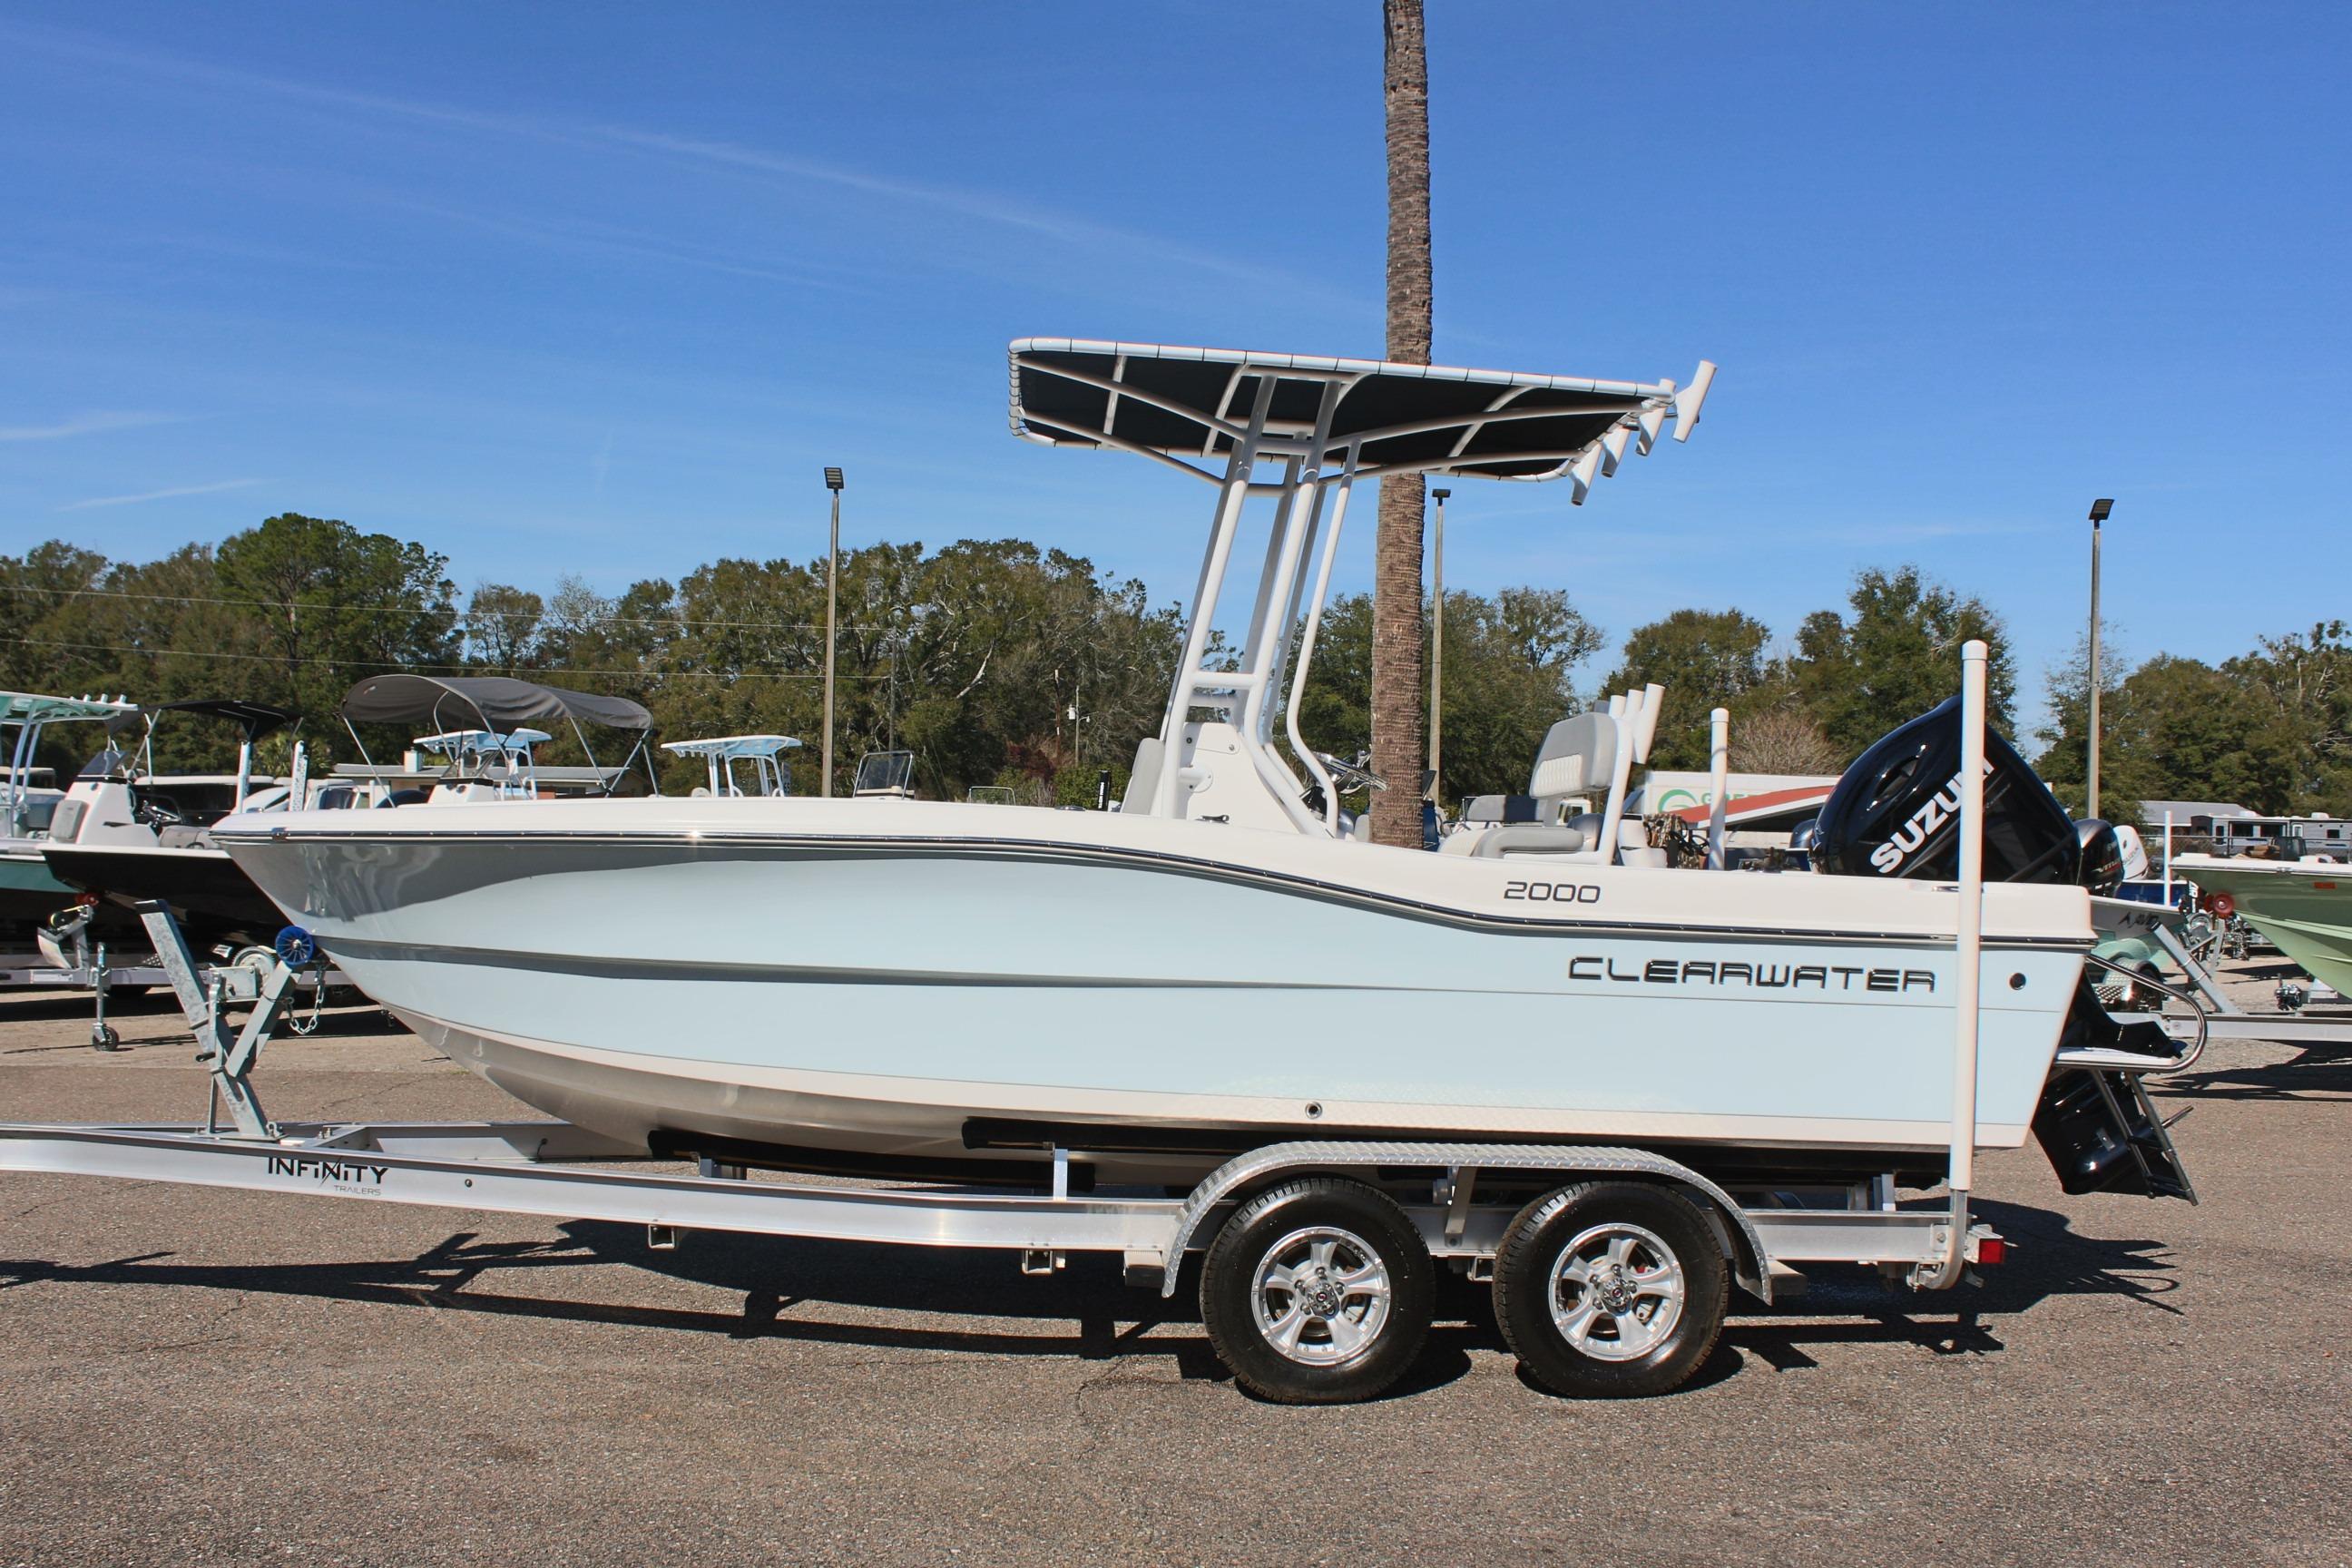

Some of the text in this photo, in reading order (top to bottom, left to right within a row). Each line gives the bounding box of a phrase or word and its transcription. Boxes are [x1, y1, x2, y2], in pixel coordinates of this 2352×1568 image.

[1870, 756, 1994, 874] SUZUI
[1504, 881, 1601, 904] 2000
[1568, 956, 1935, 993] CLEARWATER
[334, 1184, 381, 1197] TRAILERS
